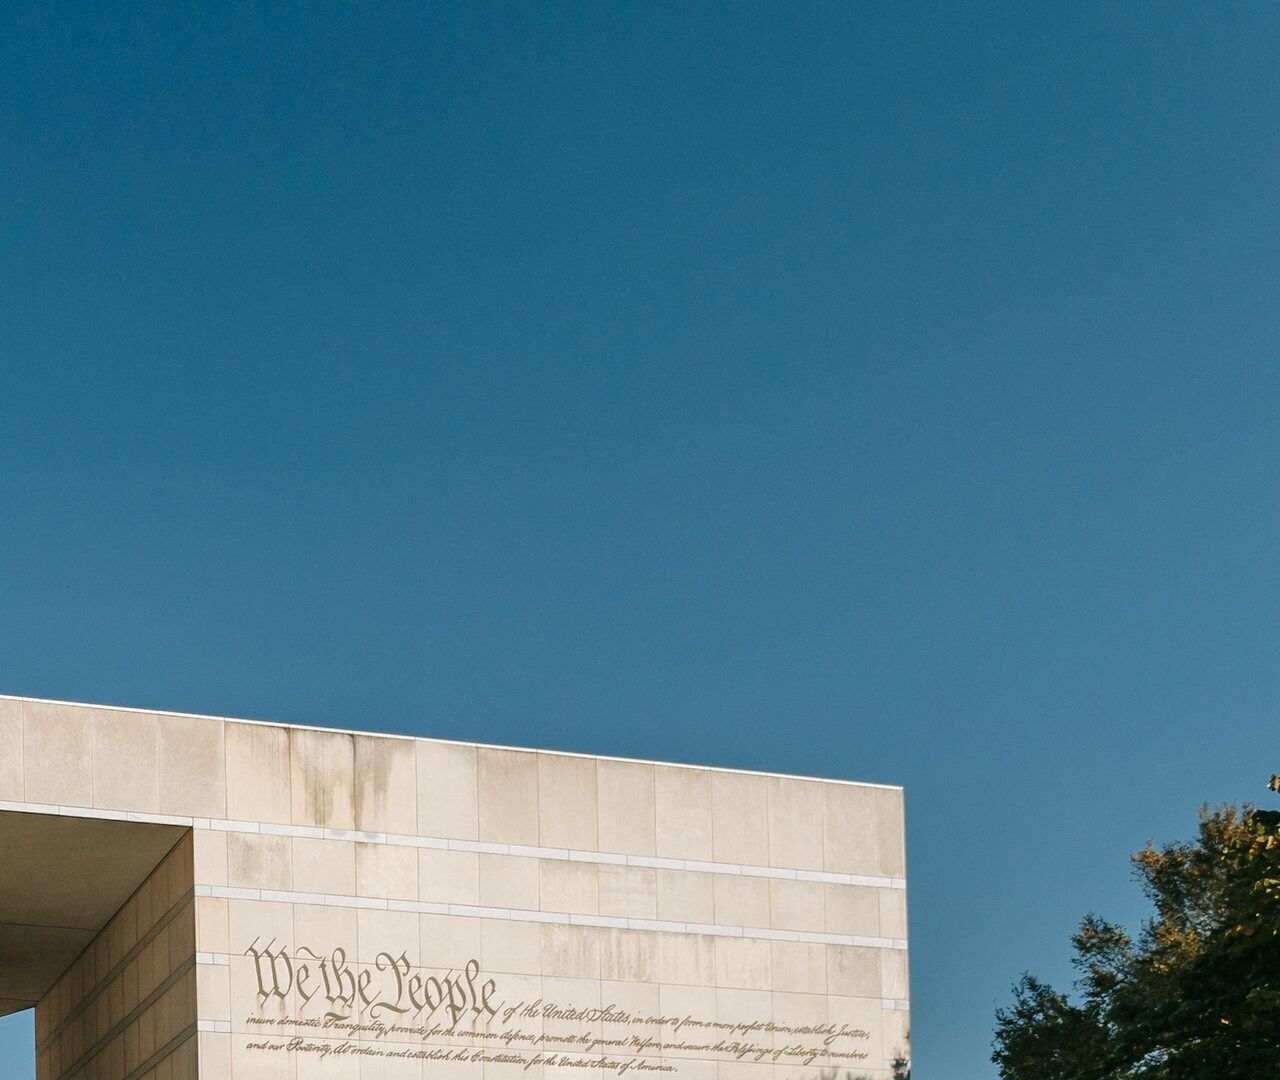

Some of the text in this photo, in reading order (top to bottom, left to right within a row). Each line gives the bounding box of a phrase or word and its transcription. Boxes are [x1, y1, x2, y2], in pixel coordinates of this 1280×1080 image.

[244, 936, 321, 1009] We
[318, 947, 382, 1014] the
[370, 950, 504, 1027] People
[503, 1002, 524, 1024] of
[520, 999, 542, 1018] the
[542, 1003, 587, 1021] United
[585, 1004, 631, 1025] States,
[277, 1016, 322, 1028] domestic
[457, 1029, 499, 1039] common
[576, 1031, 591, 1043] the
[246, 1040, 268, 1050] and
[451, 1048, 469, 1061] this
[471, 1048, 529, 1064] Constitution
[558, 1056, 591, 1068] United
